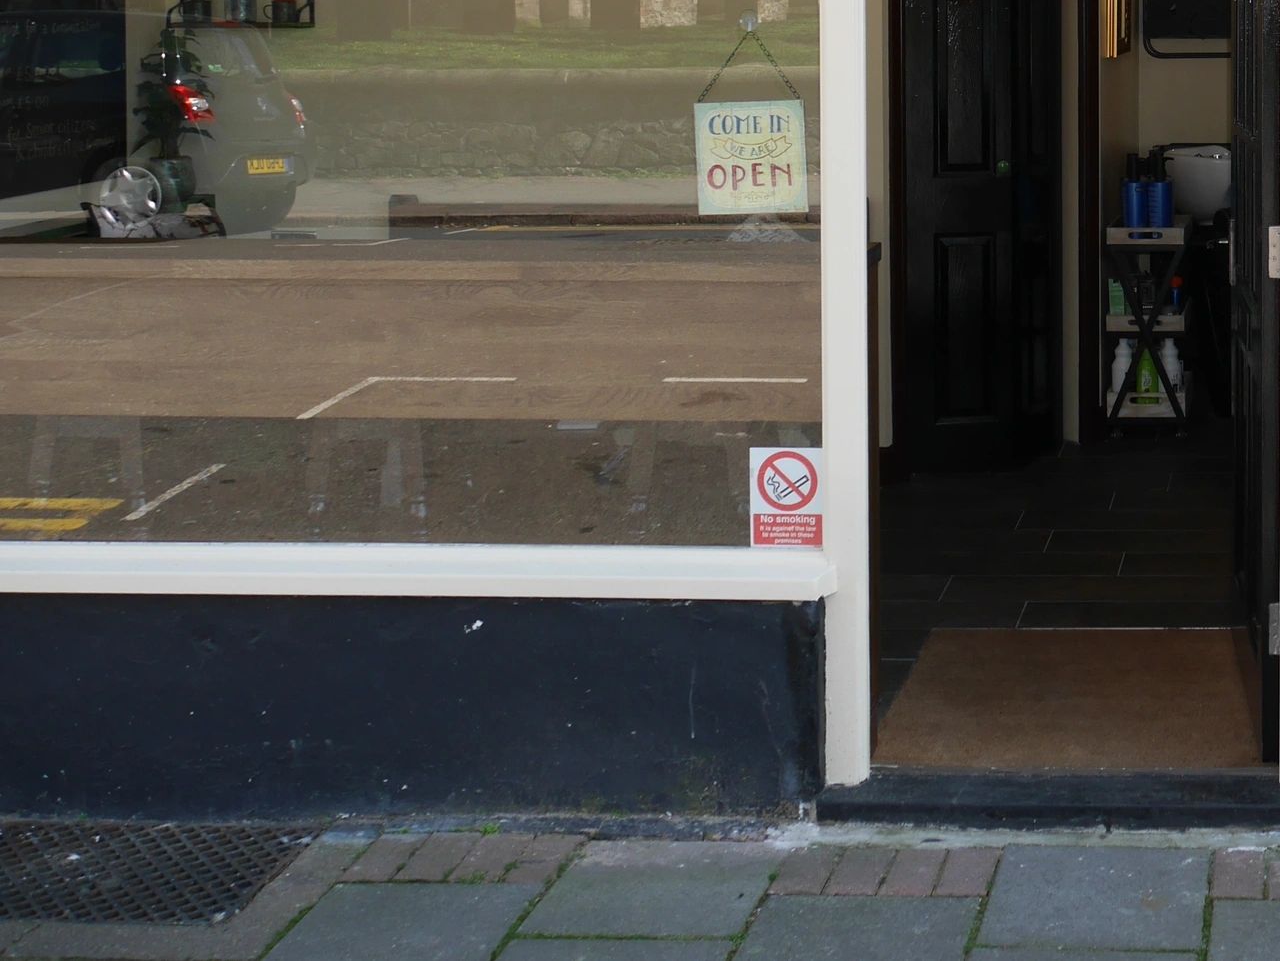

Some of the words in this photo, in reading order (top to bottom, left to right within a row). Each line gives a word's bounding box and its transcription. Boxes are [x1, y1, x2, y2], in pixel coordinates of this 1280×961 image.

[708, 113, 762, 135] COME
[769, 114, 791, 134] IN
[730, 142, 746, 157] WE
[707, 162, 792, 191] OPEN
[760, 514, 774, 523] No
[776, 514, 816, 526] smoking
